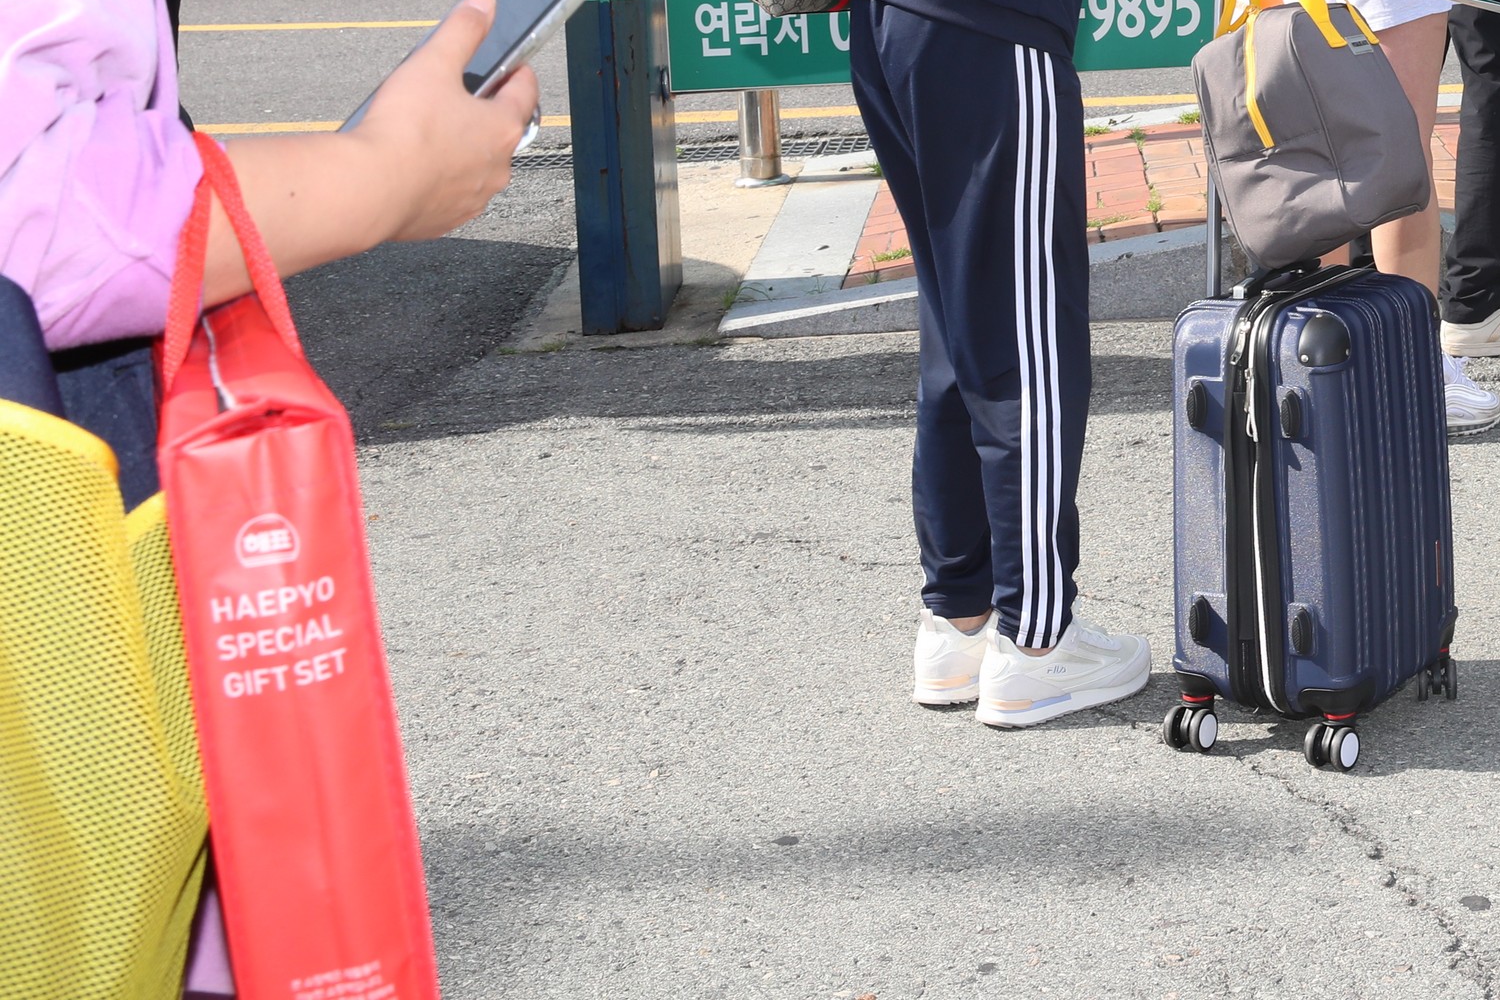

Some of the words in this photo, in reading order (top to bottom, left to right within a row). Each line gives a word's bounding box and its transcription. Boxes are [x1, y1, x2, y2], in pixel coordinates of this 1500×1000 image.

[209, 575, 336, 624] HAEPYO
[216, 613, 344, 661] SPECIAL
[223, 665, 289, 699] GIFT
[293, 647, 348, 686] SET
